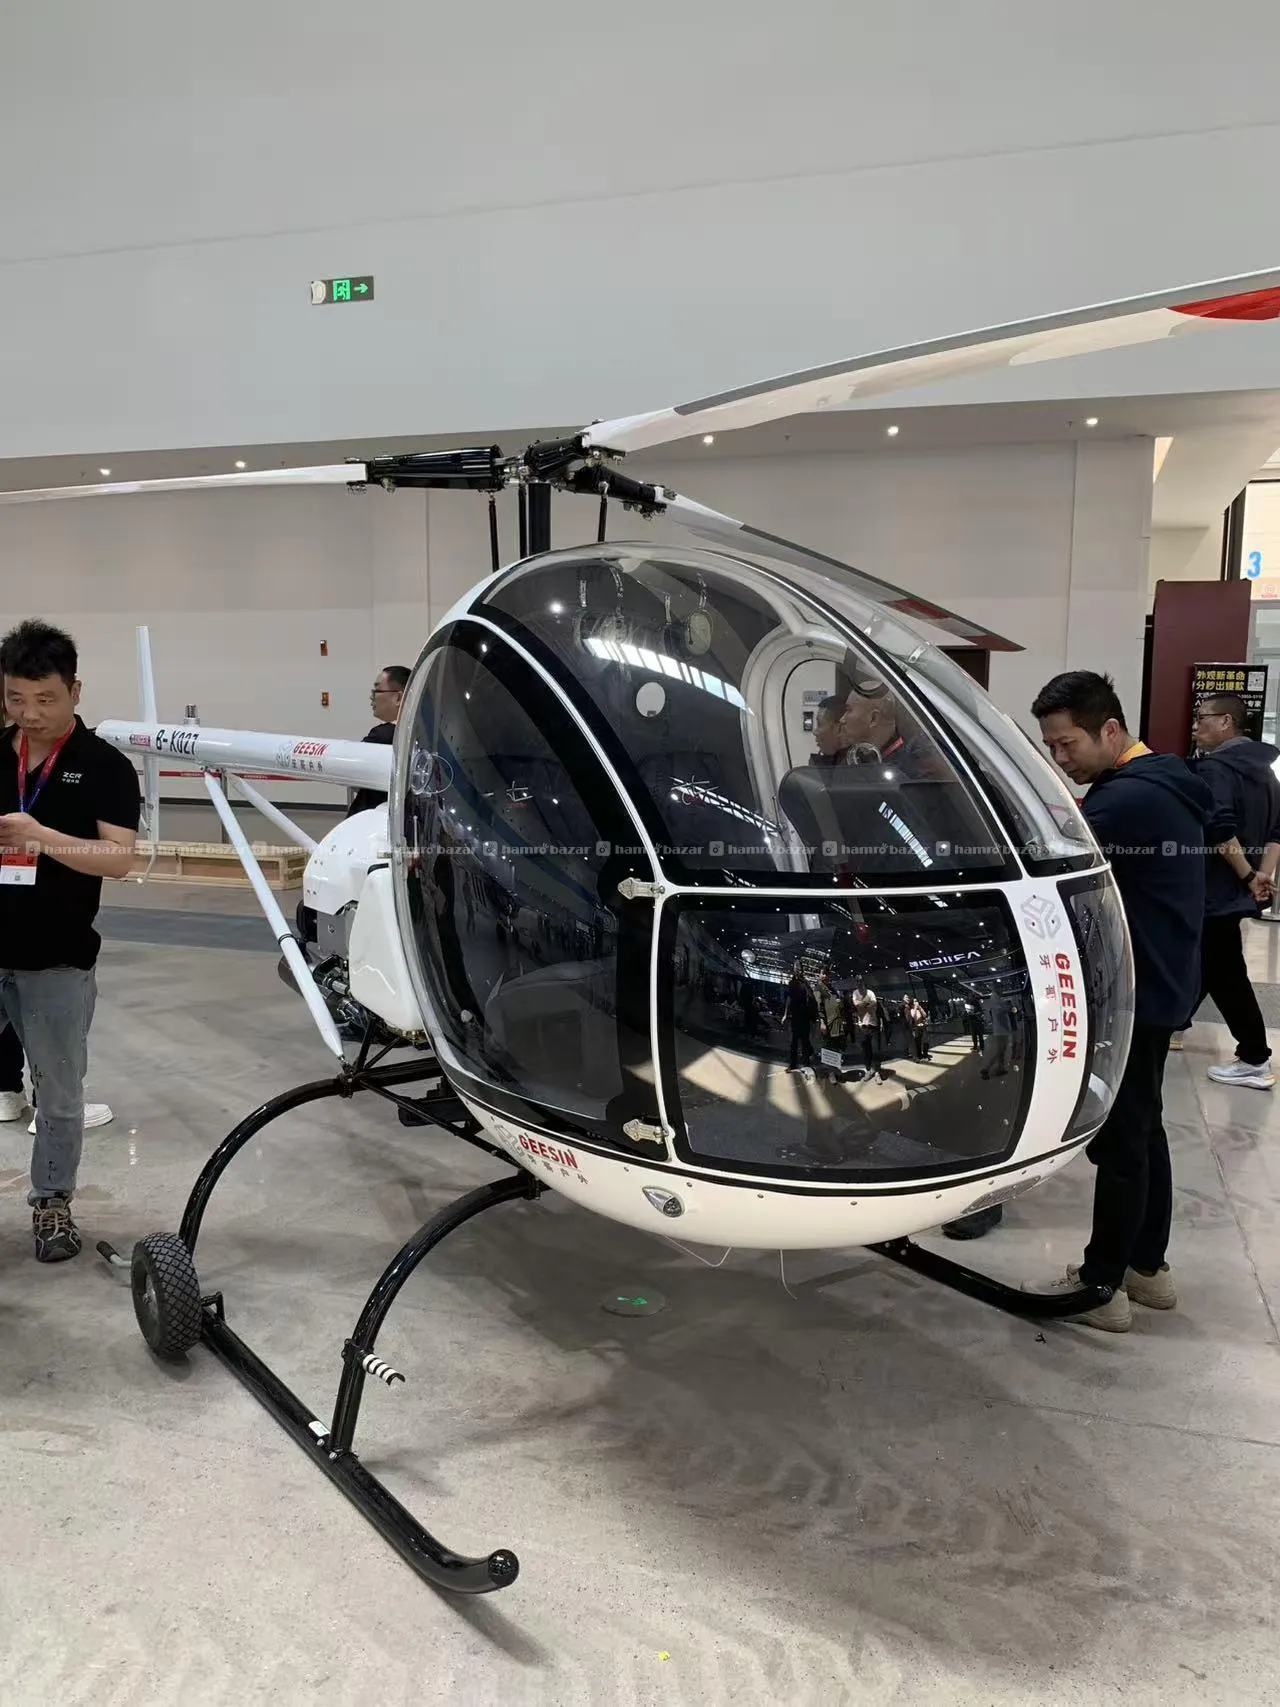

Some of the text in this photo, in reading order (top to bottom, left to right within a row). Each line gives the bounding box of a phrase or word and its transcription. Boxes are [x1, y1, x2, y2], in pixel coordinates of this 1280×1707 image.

[1247, 551, 1262, 578] 3
[1196, 670, 1246, 681] 外观新革命
[293, 741, 329, 756] GEESIN
[62, 771, 82, 779] ZCR
[1055, 952, 1077, 1059] GEESIN
[519, 1134, 578, 1169] GEESIN
